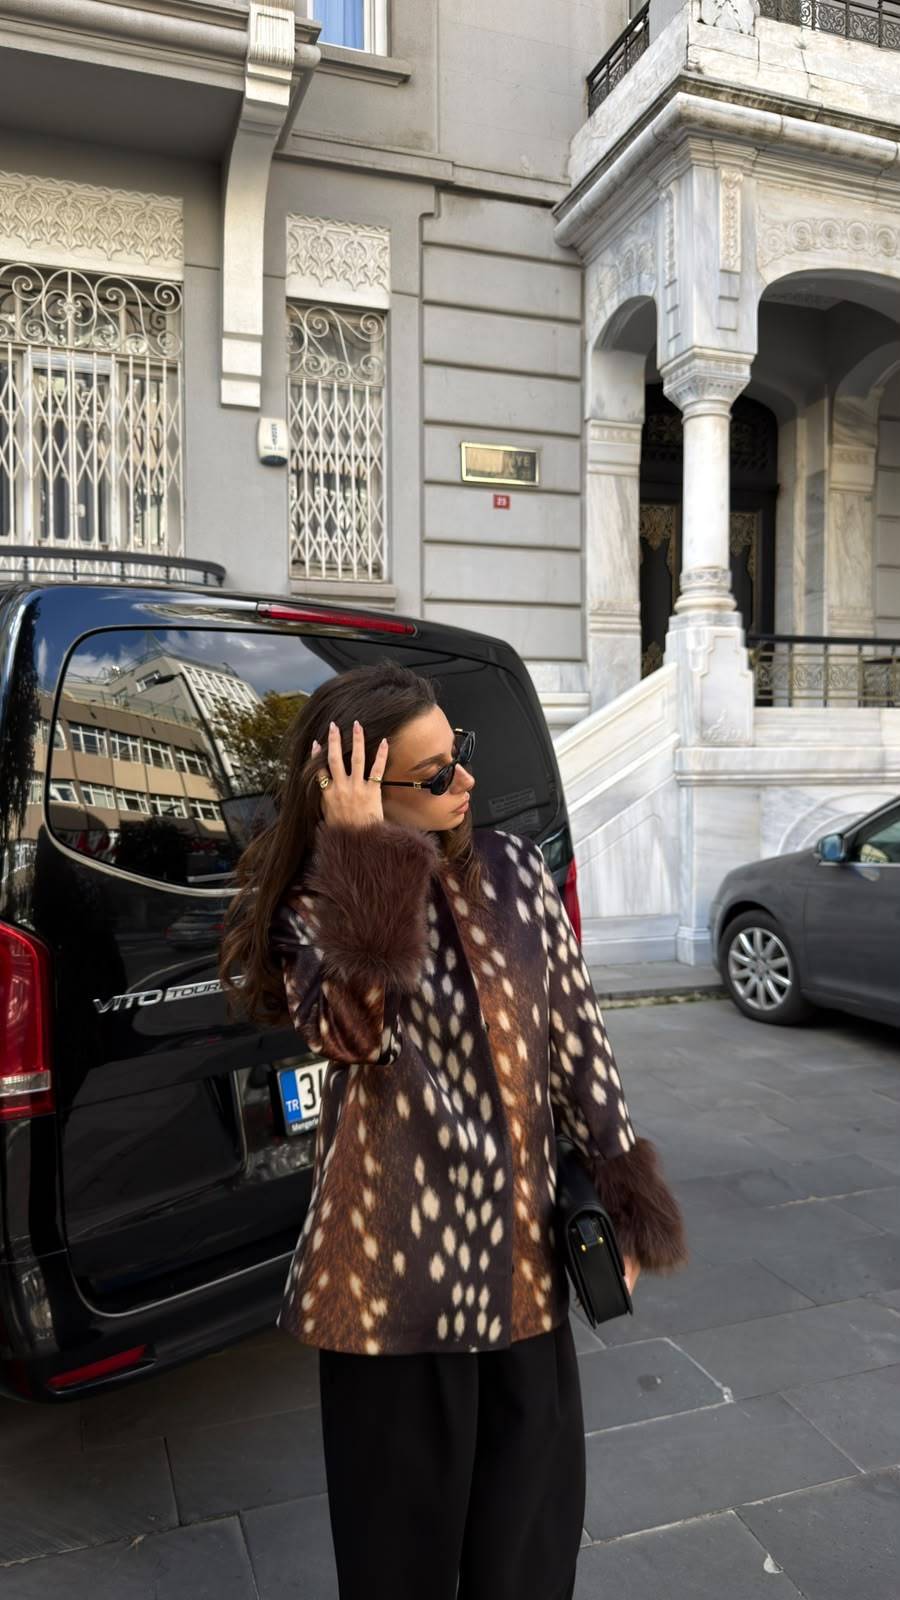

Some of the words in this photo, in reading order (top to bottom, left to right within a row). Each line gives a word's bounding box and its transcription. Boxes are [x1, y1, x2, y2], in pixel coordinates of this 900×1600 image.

[93, 989, 163, 1013] VITO
[167, 976, 247, 1000] TOUR
[286, 1099, 299, 1112] TR
